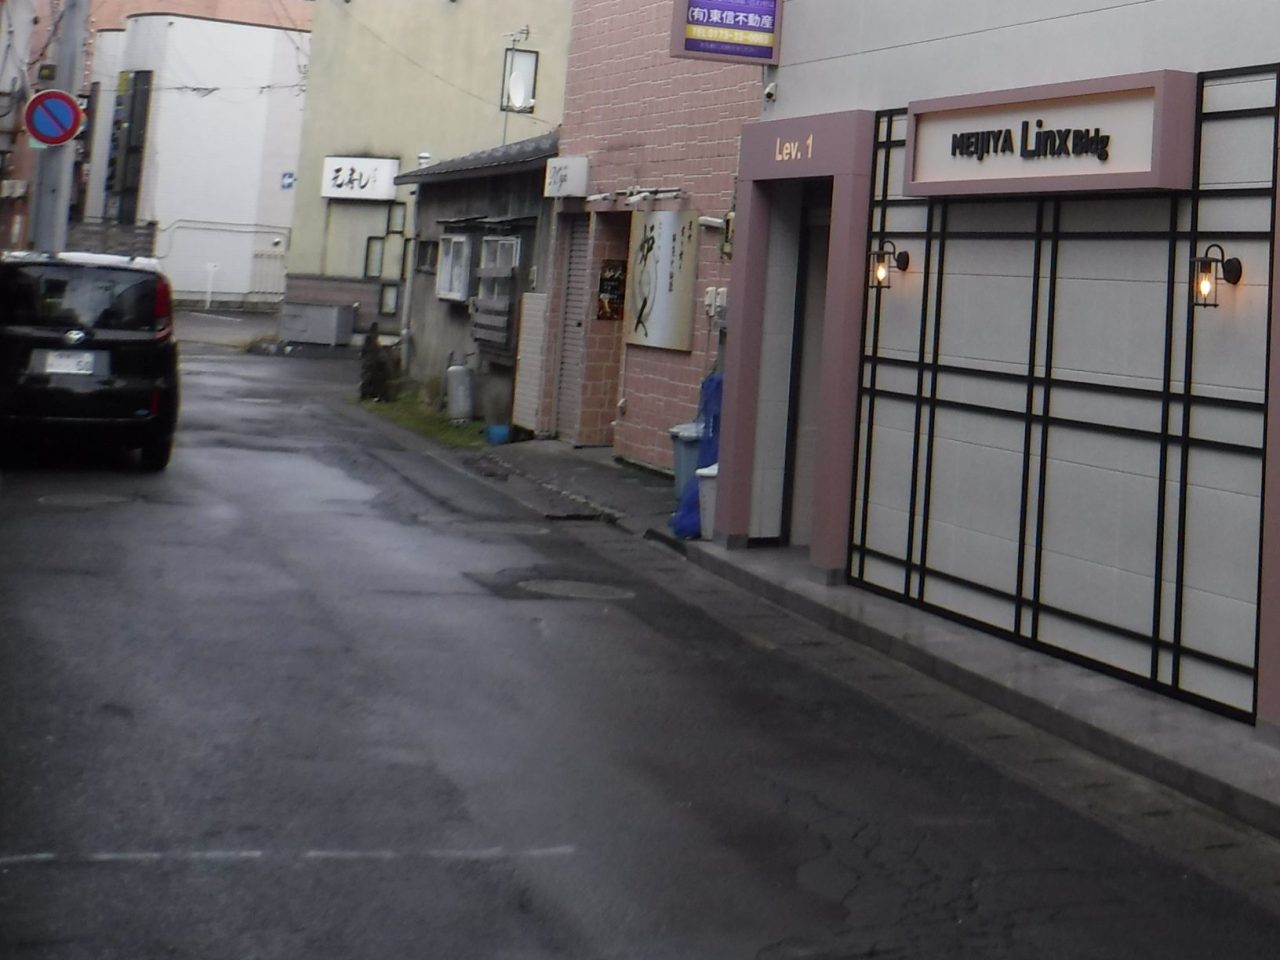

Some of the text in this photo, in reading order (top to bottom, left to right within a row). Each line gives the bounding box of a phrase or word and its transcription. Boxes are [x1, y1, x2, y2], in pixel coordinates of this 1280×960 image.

[775, 133, 814, 161] Lev. 1
[951, 128, 1014, 161] MEIJIYA
[1020, 119, 1072, 159] Linx
